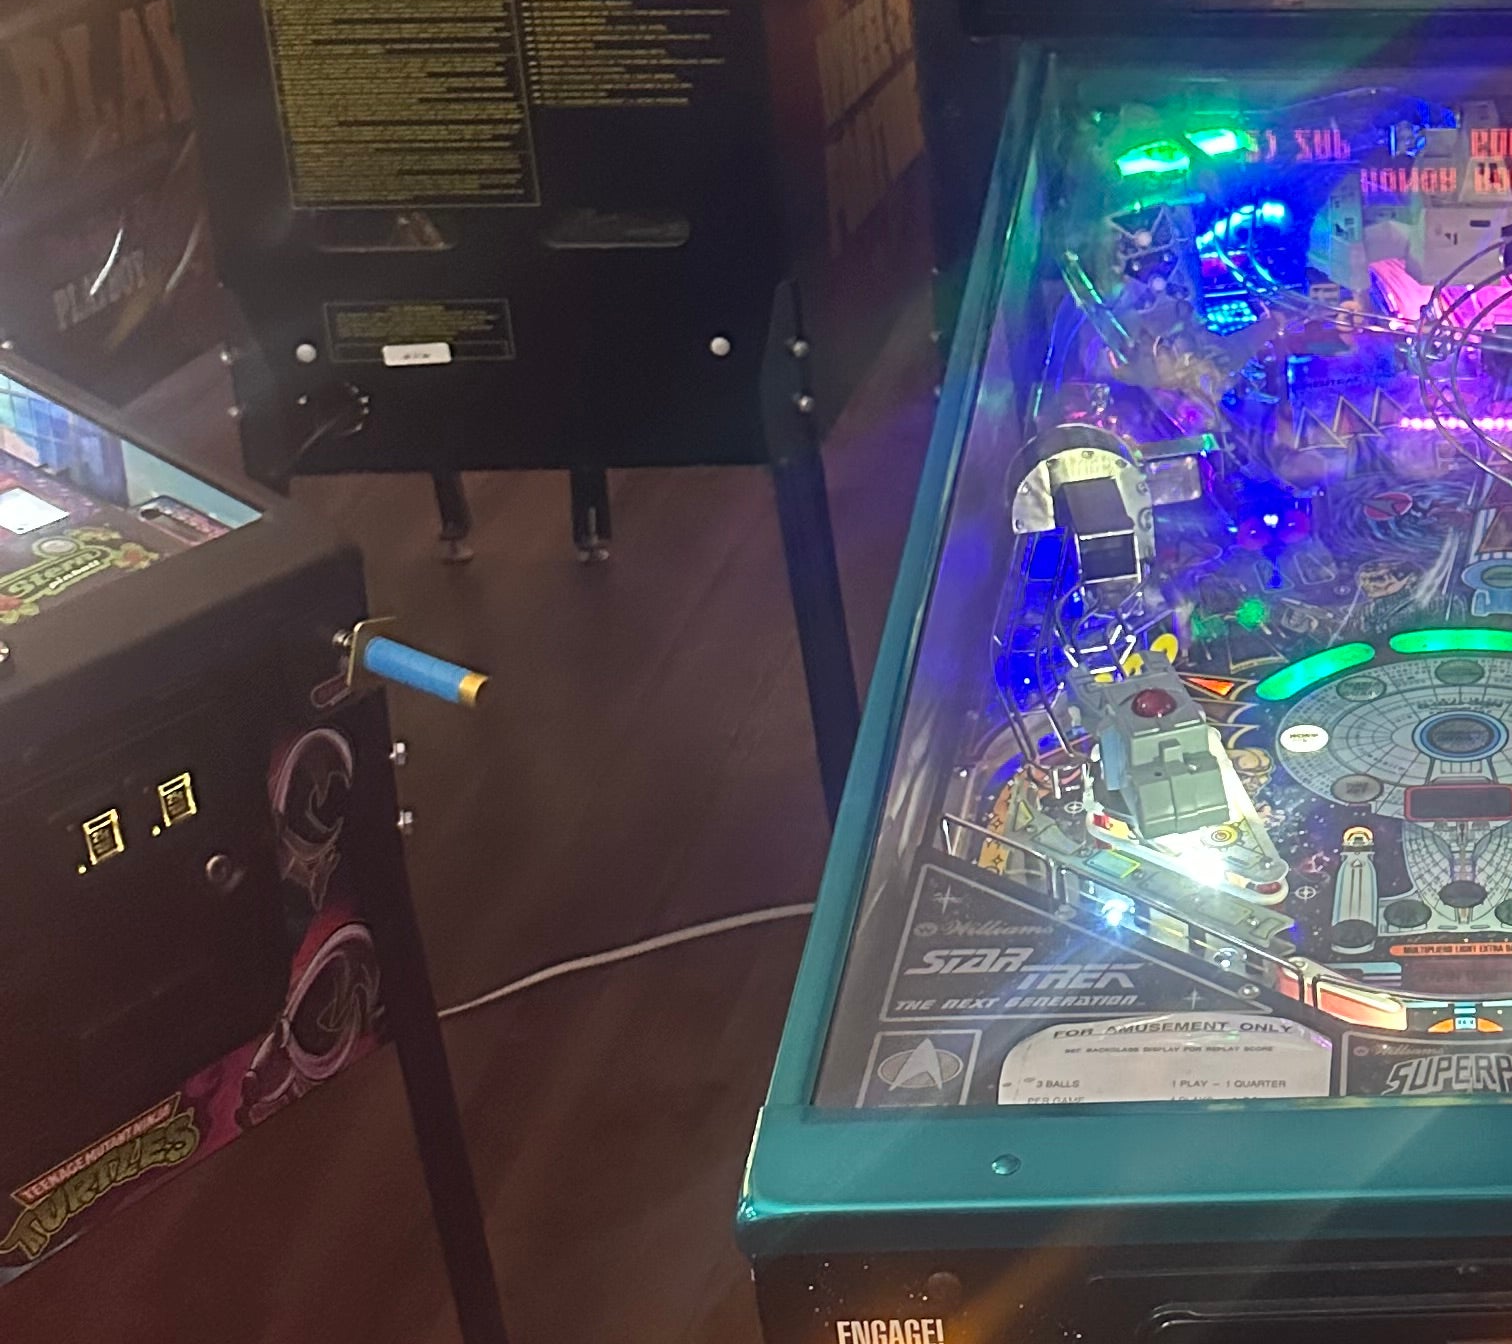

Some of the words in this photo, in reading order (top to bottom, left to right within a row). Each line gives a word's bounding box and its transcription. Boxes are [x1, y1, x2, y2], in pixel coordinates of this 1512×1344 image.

[8, 550, 102, 594] Stern
[903, 947, 1035, 976] STAR
[1016, 962, 1145, 990] TREK
[895, 999, 937, 1012] THE
[941, 997, 1003, 1010] NEXT
[1004, 994, 1139, 1008] GENERATION
[1053, 1027, 1094, 1040] FOR
[1105, 1021, 1231, 1035] AMUSEMENT
[1238, 1022, 1293, 1034] ONLY
[1036, 1080, 1043, 1088] 3
[1045, 1079, 1080, 1089] BALLS
[1180, 1080, 1208, 1088] PLAY
[1233, 1079, 1287, 1089] QUARTER
[21, 1155, 86, 1199] TEENAGE
